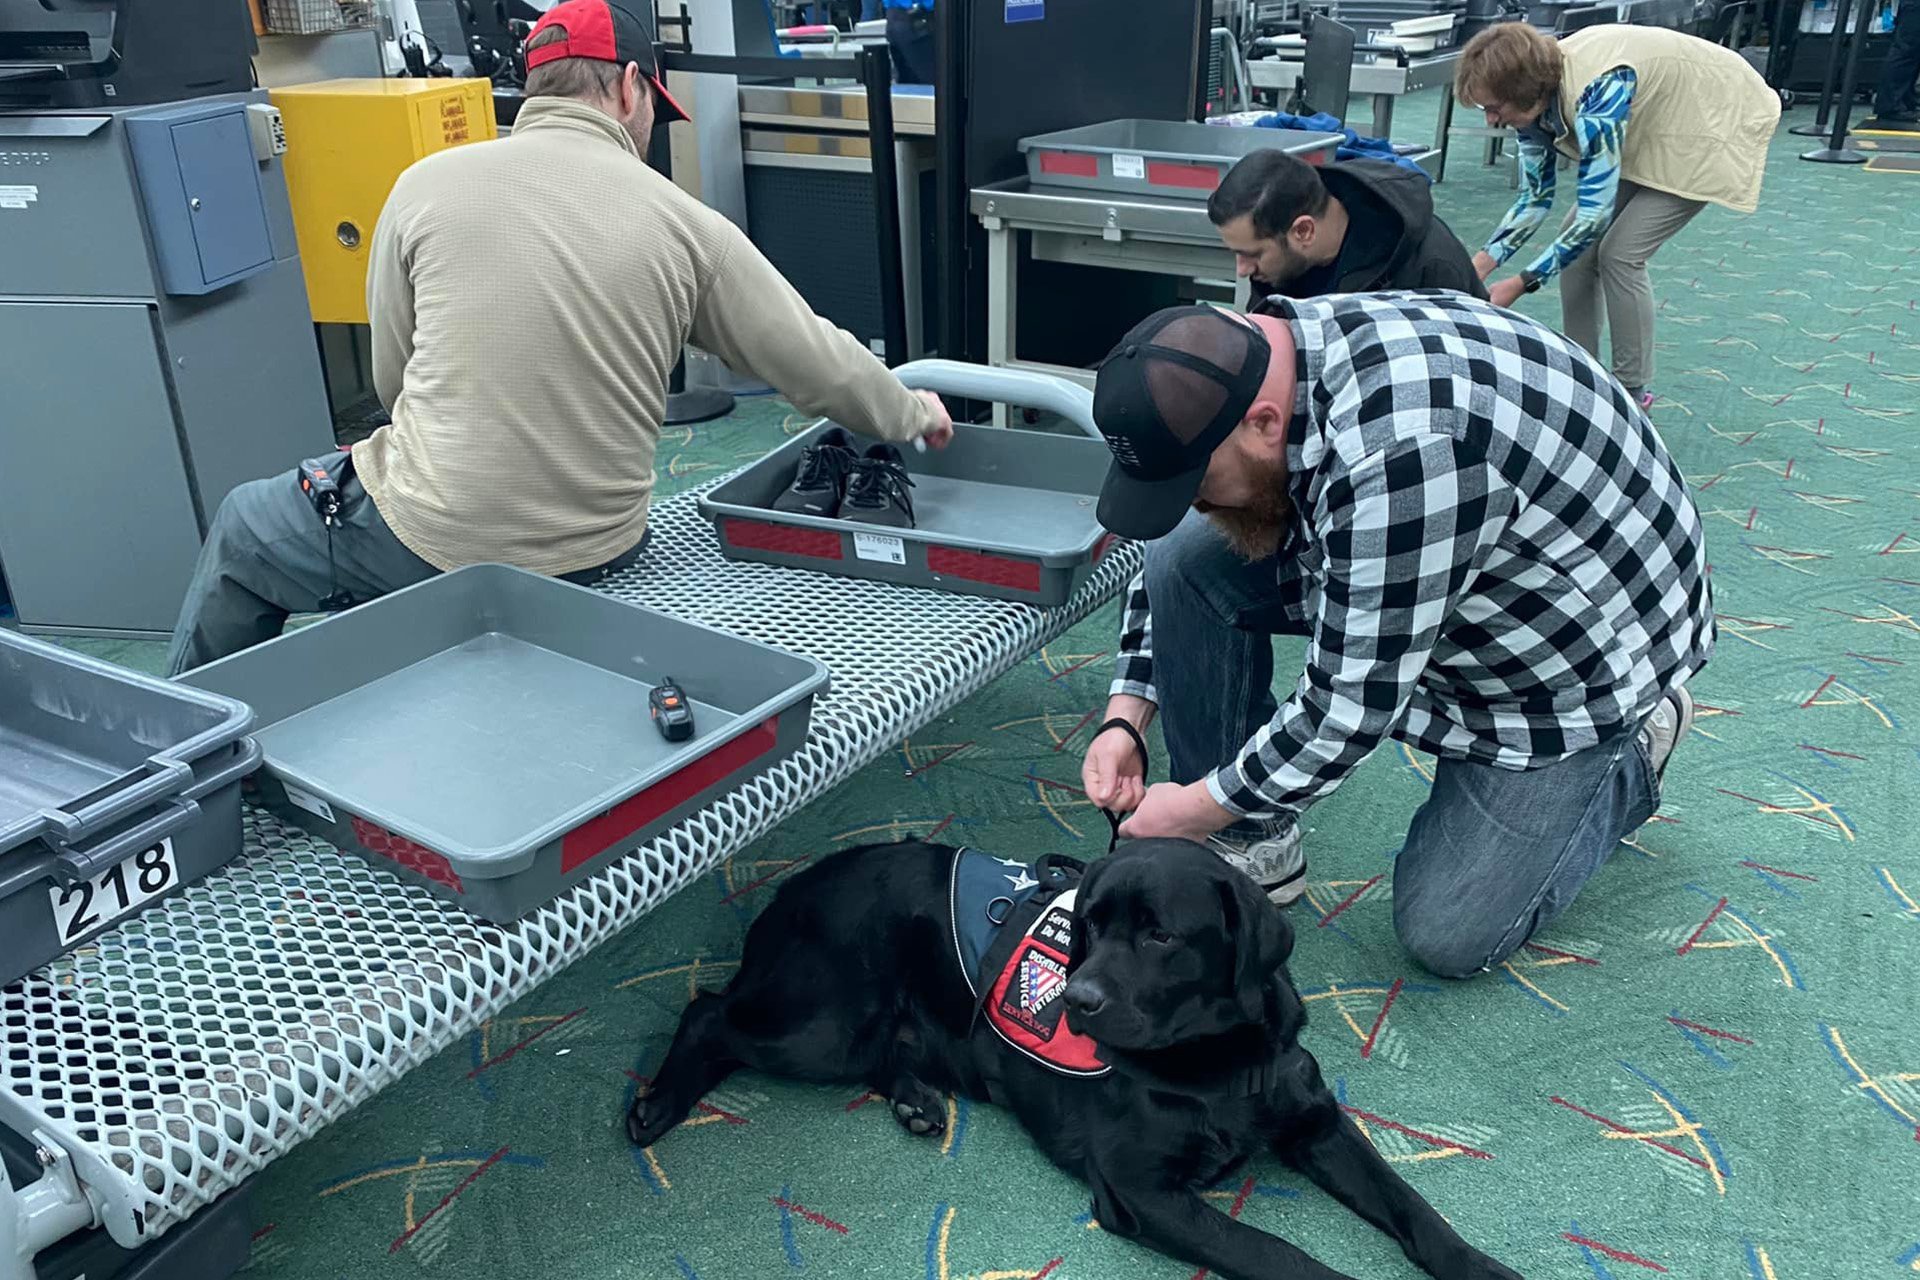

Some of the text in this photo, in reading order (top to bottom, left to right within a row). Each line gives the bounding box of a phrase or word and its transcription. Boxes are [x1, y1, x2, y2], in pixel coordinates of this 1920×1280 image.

[59, 842, 170, 939] 218
[1041, 925, 1055, 938] Do
[1048, 912, 1071, 930] Serv
[1028, 950, 1067, 978] DISABLE
[1019, 960, 1030, 1009] SERVICE
